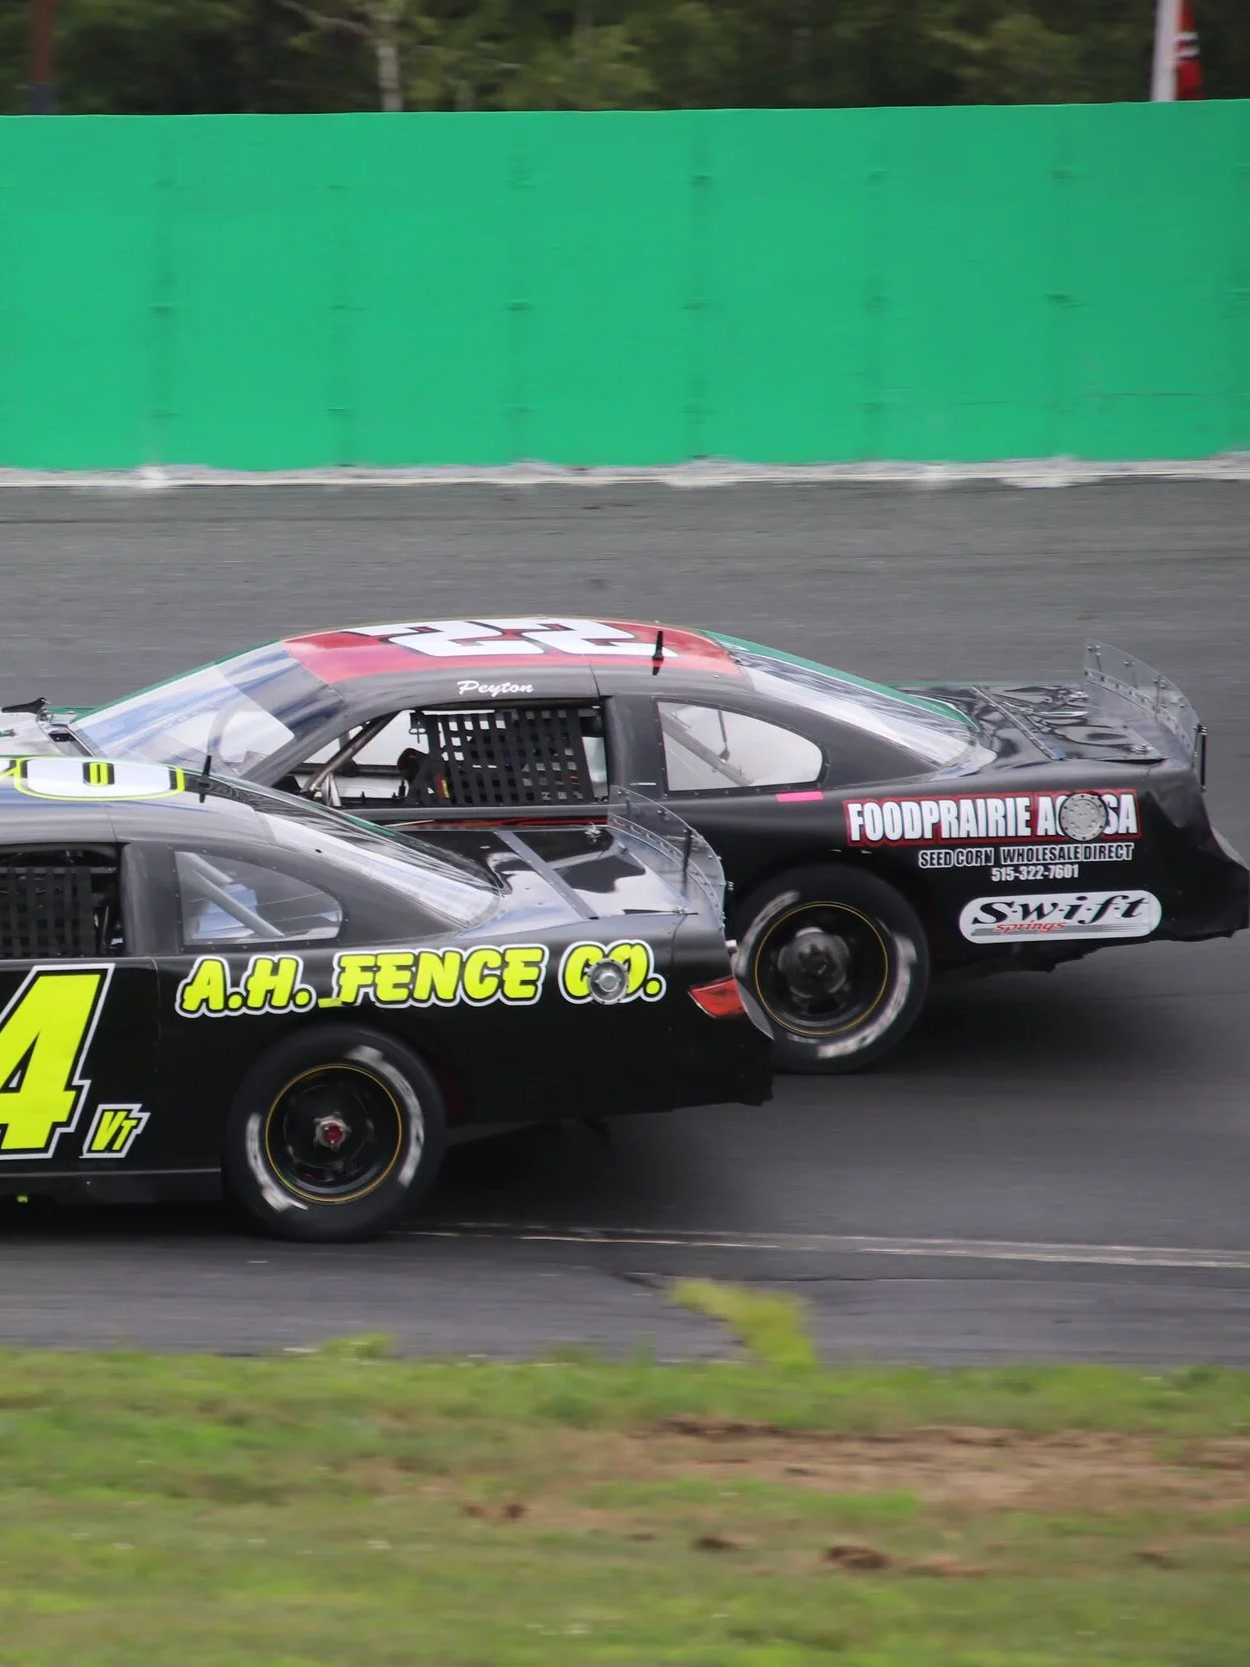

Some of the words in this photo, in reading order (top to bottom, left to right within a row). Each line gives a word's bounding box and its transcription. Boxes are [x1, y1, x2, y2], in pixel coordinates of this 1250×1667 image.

[456, 678, 534, 698] Peyton
[848, 796, 1032, 842] FOODPRAIRIE
[919, 850, 952, 868] SEED
[955, 848, 994, 867] CORN
[1000, 844, 1082, 865] WHOLESALE
[1082, 843, 1134, 862] DIRECT
[991, 864, 1079, 882] 515-322-7601
[995, 919, 1067, 935] springs
[175, 955, 317, 1018] A.H.
[333, 943, 550, 1008] FENCE
[558, 939, 667, 1005] CO.
